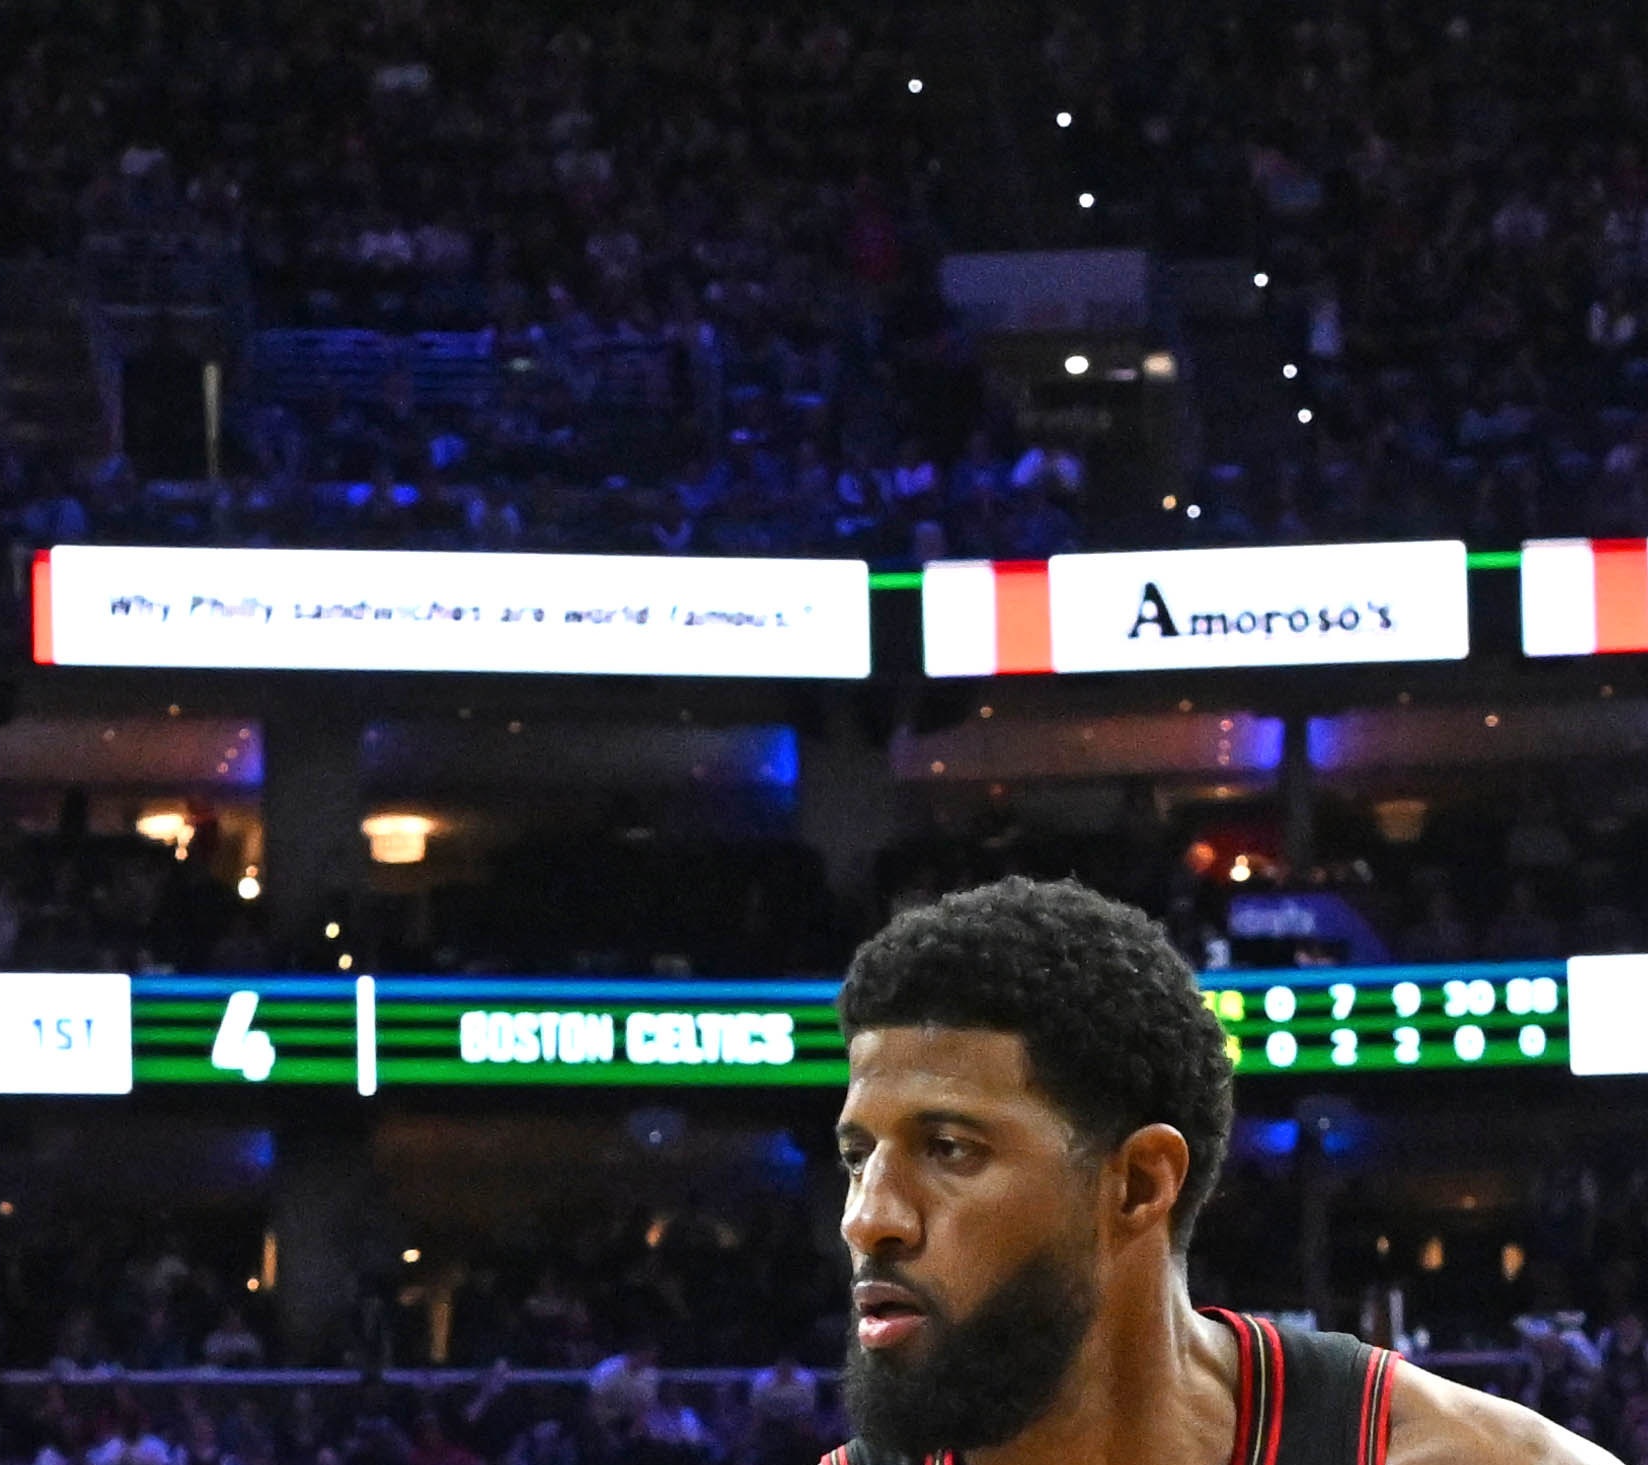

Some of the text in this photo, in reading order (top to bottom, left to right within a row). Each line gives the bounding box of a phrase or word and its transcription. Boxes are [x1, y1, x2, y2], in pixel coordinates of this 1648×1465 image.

[1130, 583, 1391, 637] Amoroso's
[1264, 985, 1296, 1022] 0
[212, 992, 275, 1080] 4
[461, 1011, 793, 1063] BOSTON CELTICS
[1266, 1030, 1297, 1068] 0
[1454, 1024, 1485, 1061] 0
